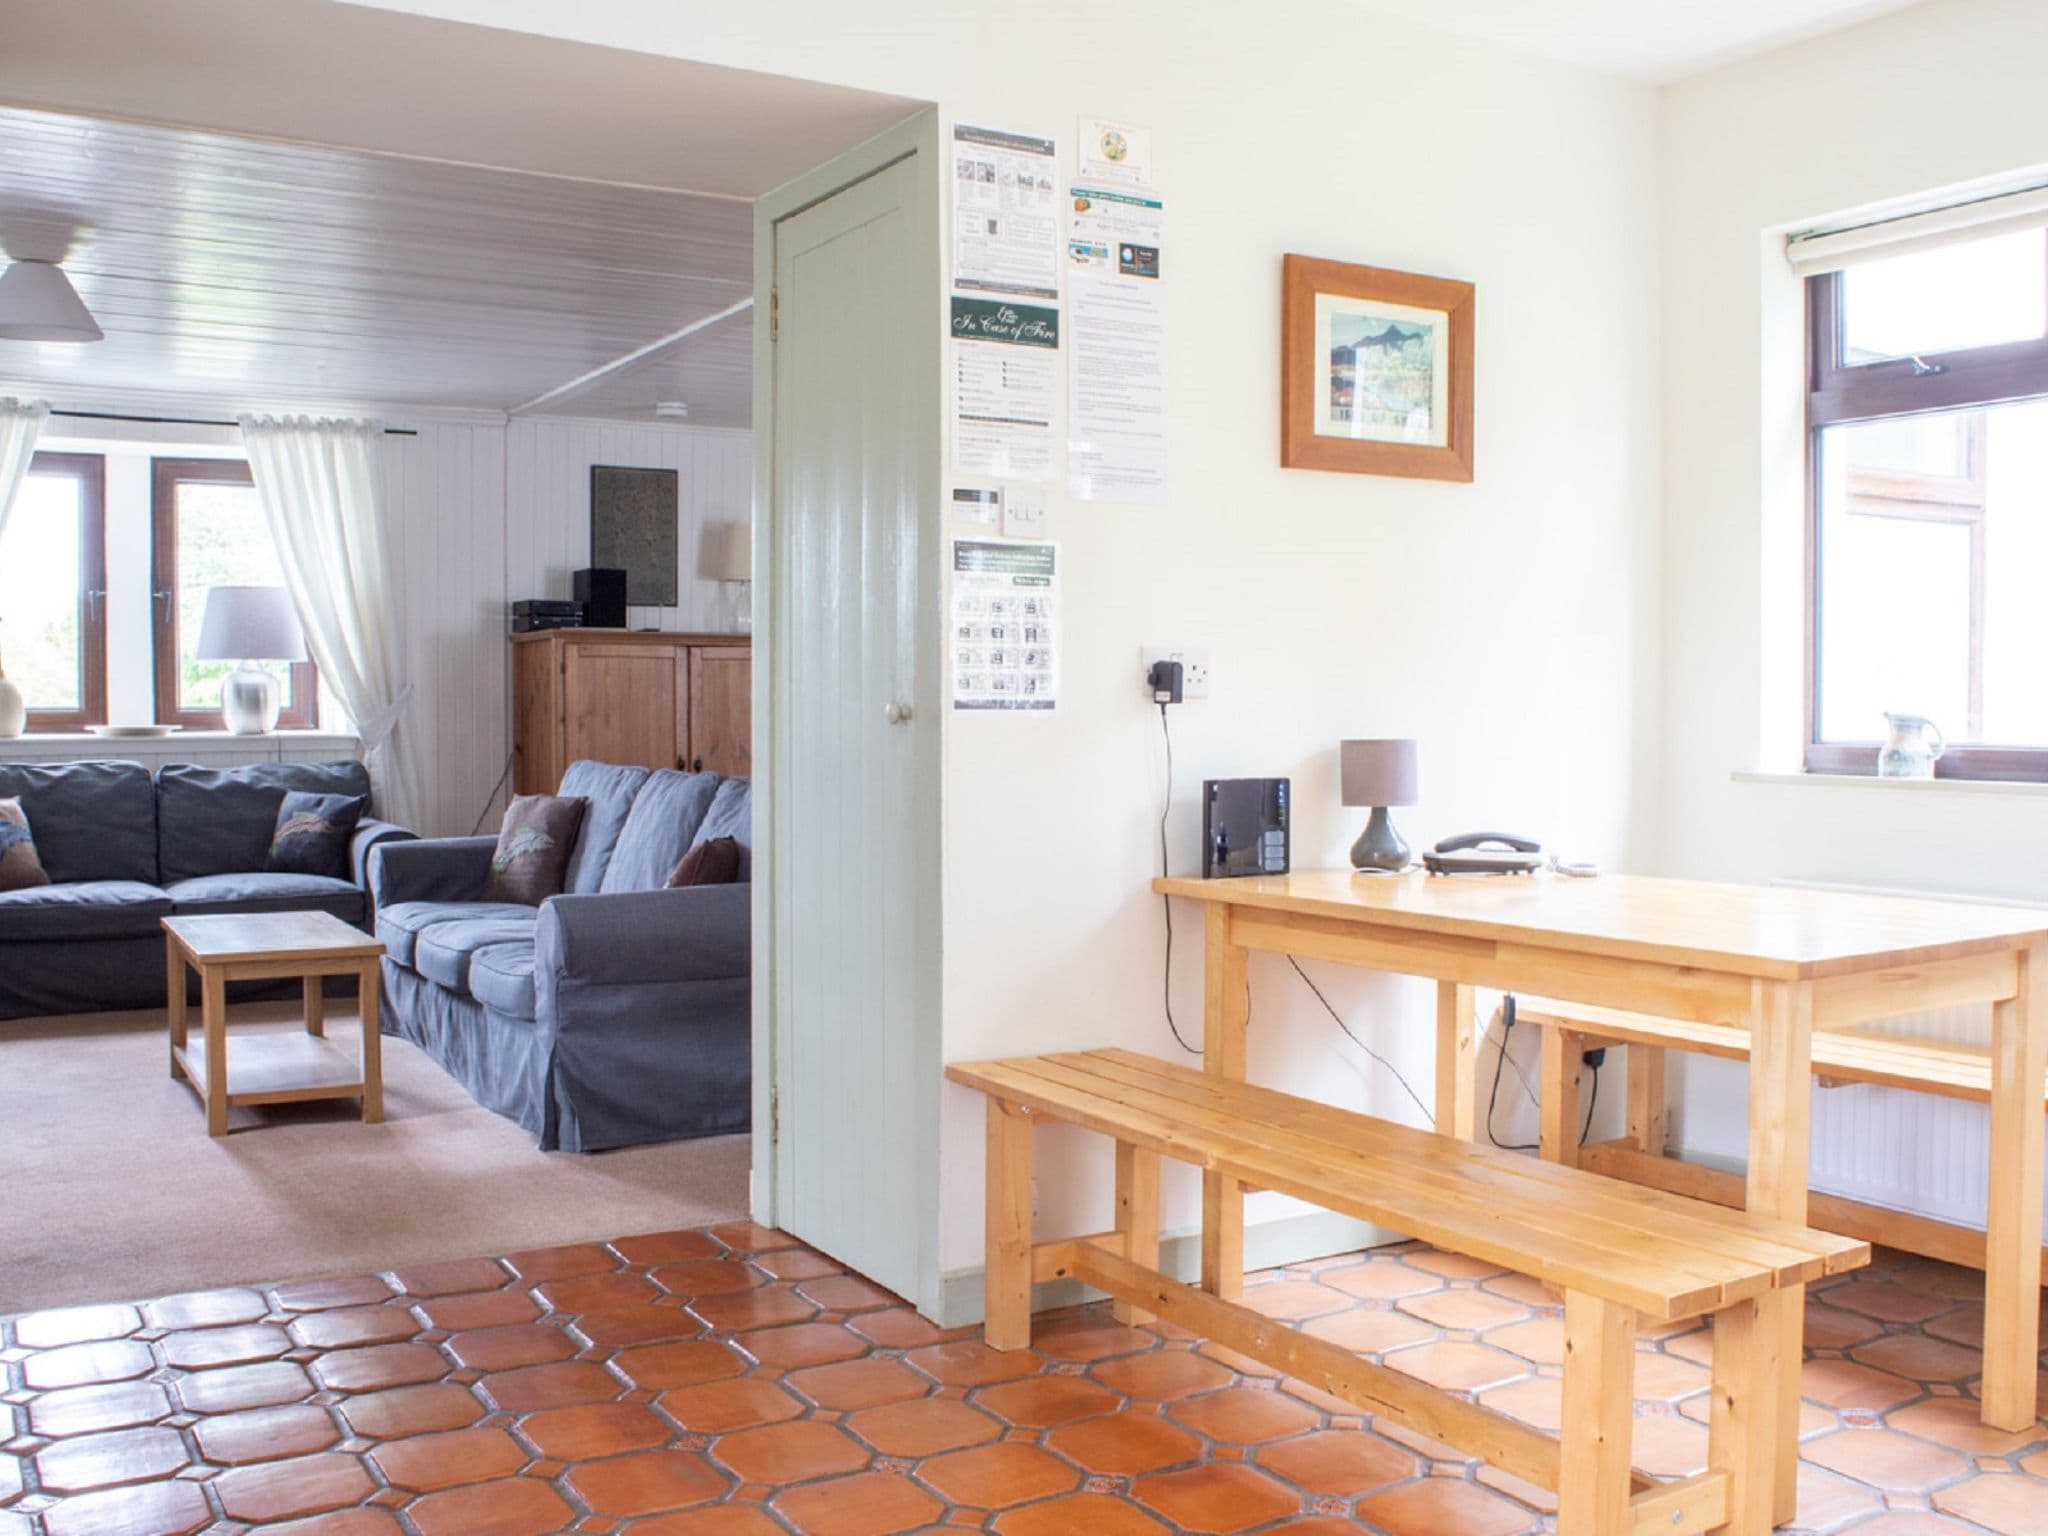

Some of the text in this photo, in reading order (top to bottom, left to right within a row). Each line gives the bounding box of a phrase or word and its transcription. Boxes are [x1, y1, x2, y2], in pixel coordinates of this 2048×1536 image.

[953, 313, 976, 330] In
[980, 314, 1009, 333] Case
[1010, 321, 1028, 341] of
[1025, 320, 1056, 340] Fire
